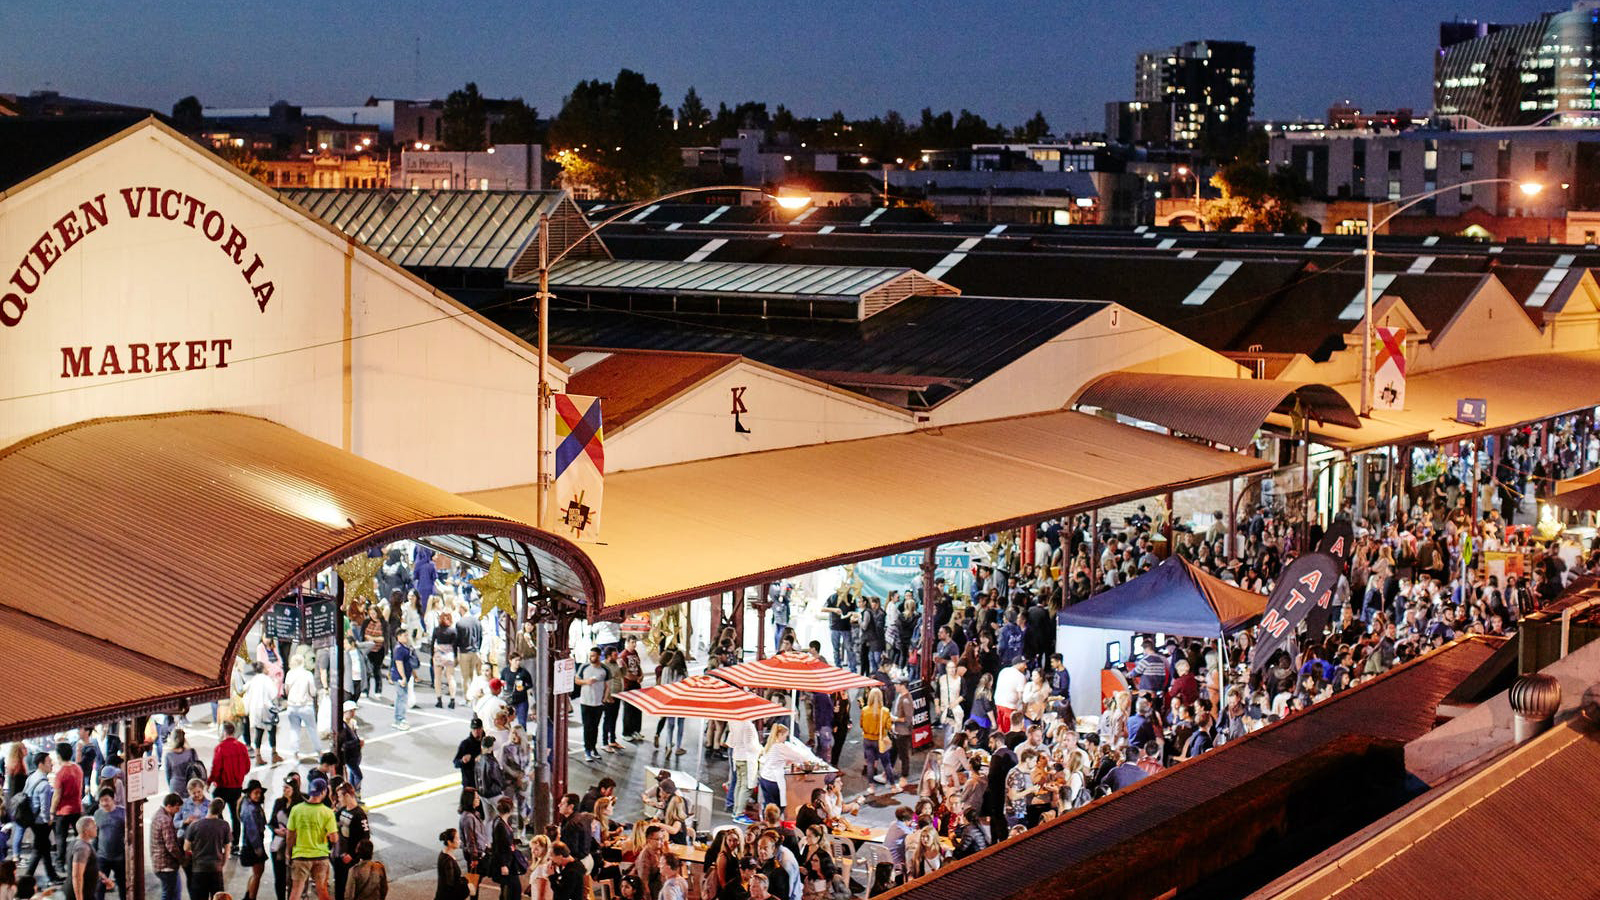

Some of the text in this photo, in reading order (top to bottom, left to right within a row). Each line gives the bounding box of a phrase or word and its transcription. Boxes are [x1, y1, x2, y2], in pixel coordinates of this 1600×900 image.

[0, 187, 275, 327] QUEEN VICTORIA
[1111, 311, 1118, 326] J
[60, 339, 232, 378] MARKET
[731, 387, 748, 414] K
[1260, 569, 1322, 638] ATM
